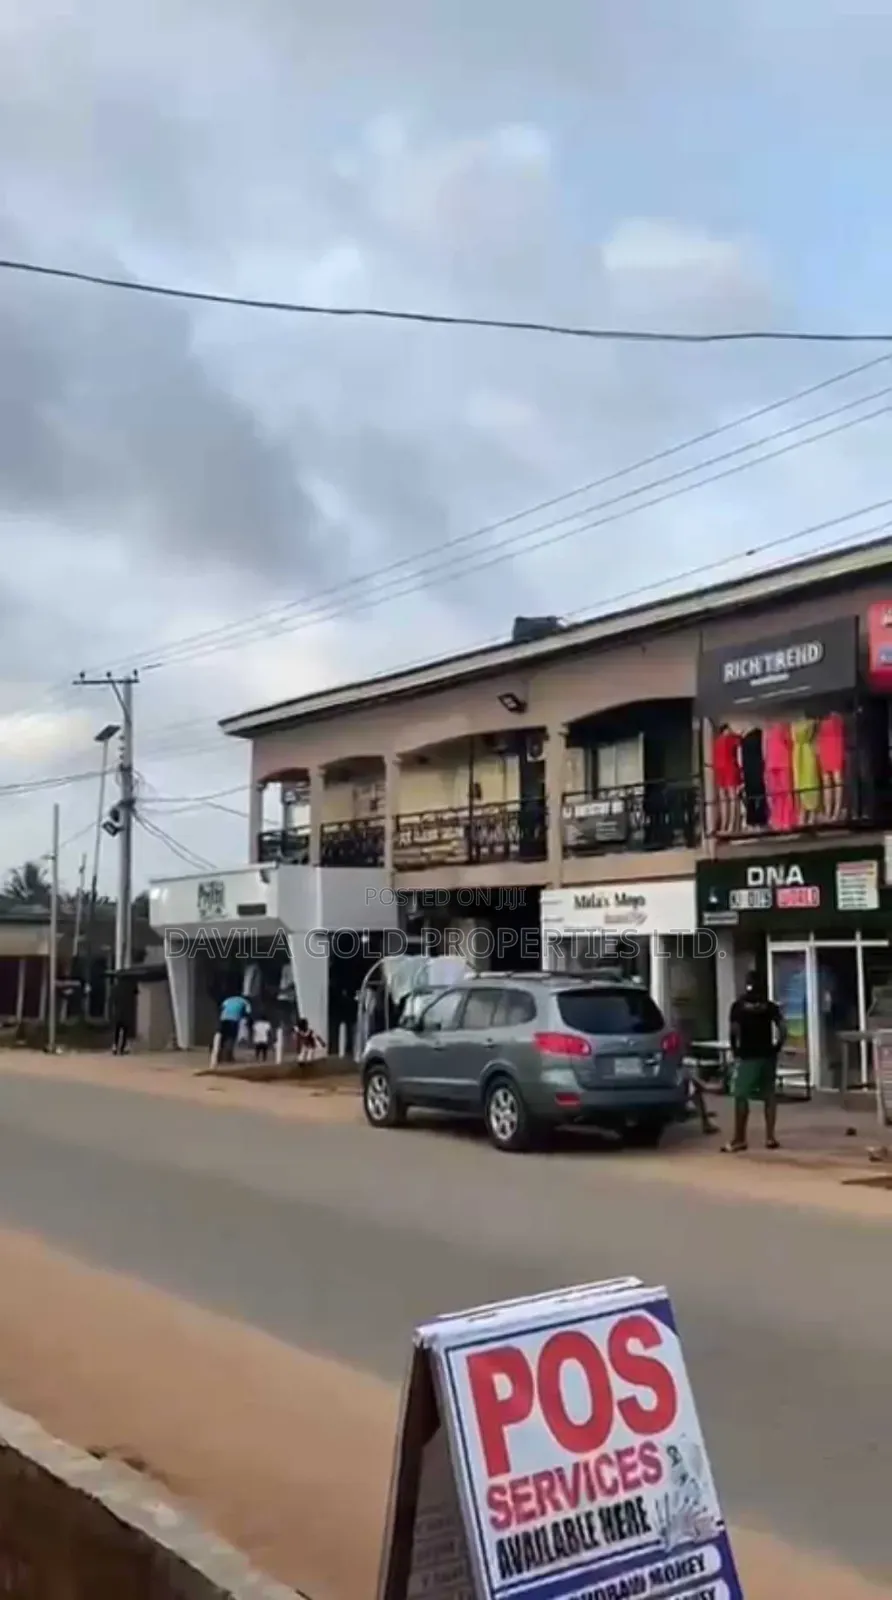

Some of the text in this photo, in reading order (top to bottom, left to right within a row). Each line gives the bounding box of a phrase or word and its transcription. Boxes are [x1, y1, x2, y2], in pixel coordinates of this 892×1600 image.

[724, 657, 762, 683] RICH
[765, 640, 825, 672] TREND
[747, 864, 804, 886] DNA
[467, 1314, 678, 1478] POS
[487, 1441, 663, 1530] SERVICES
[496, 1509, 597, 1579] AVAILABLE
[601, 1496, 651, 1542] HERE
[650, 1553, 706, 1585] MONEY
